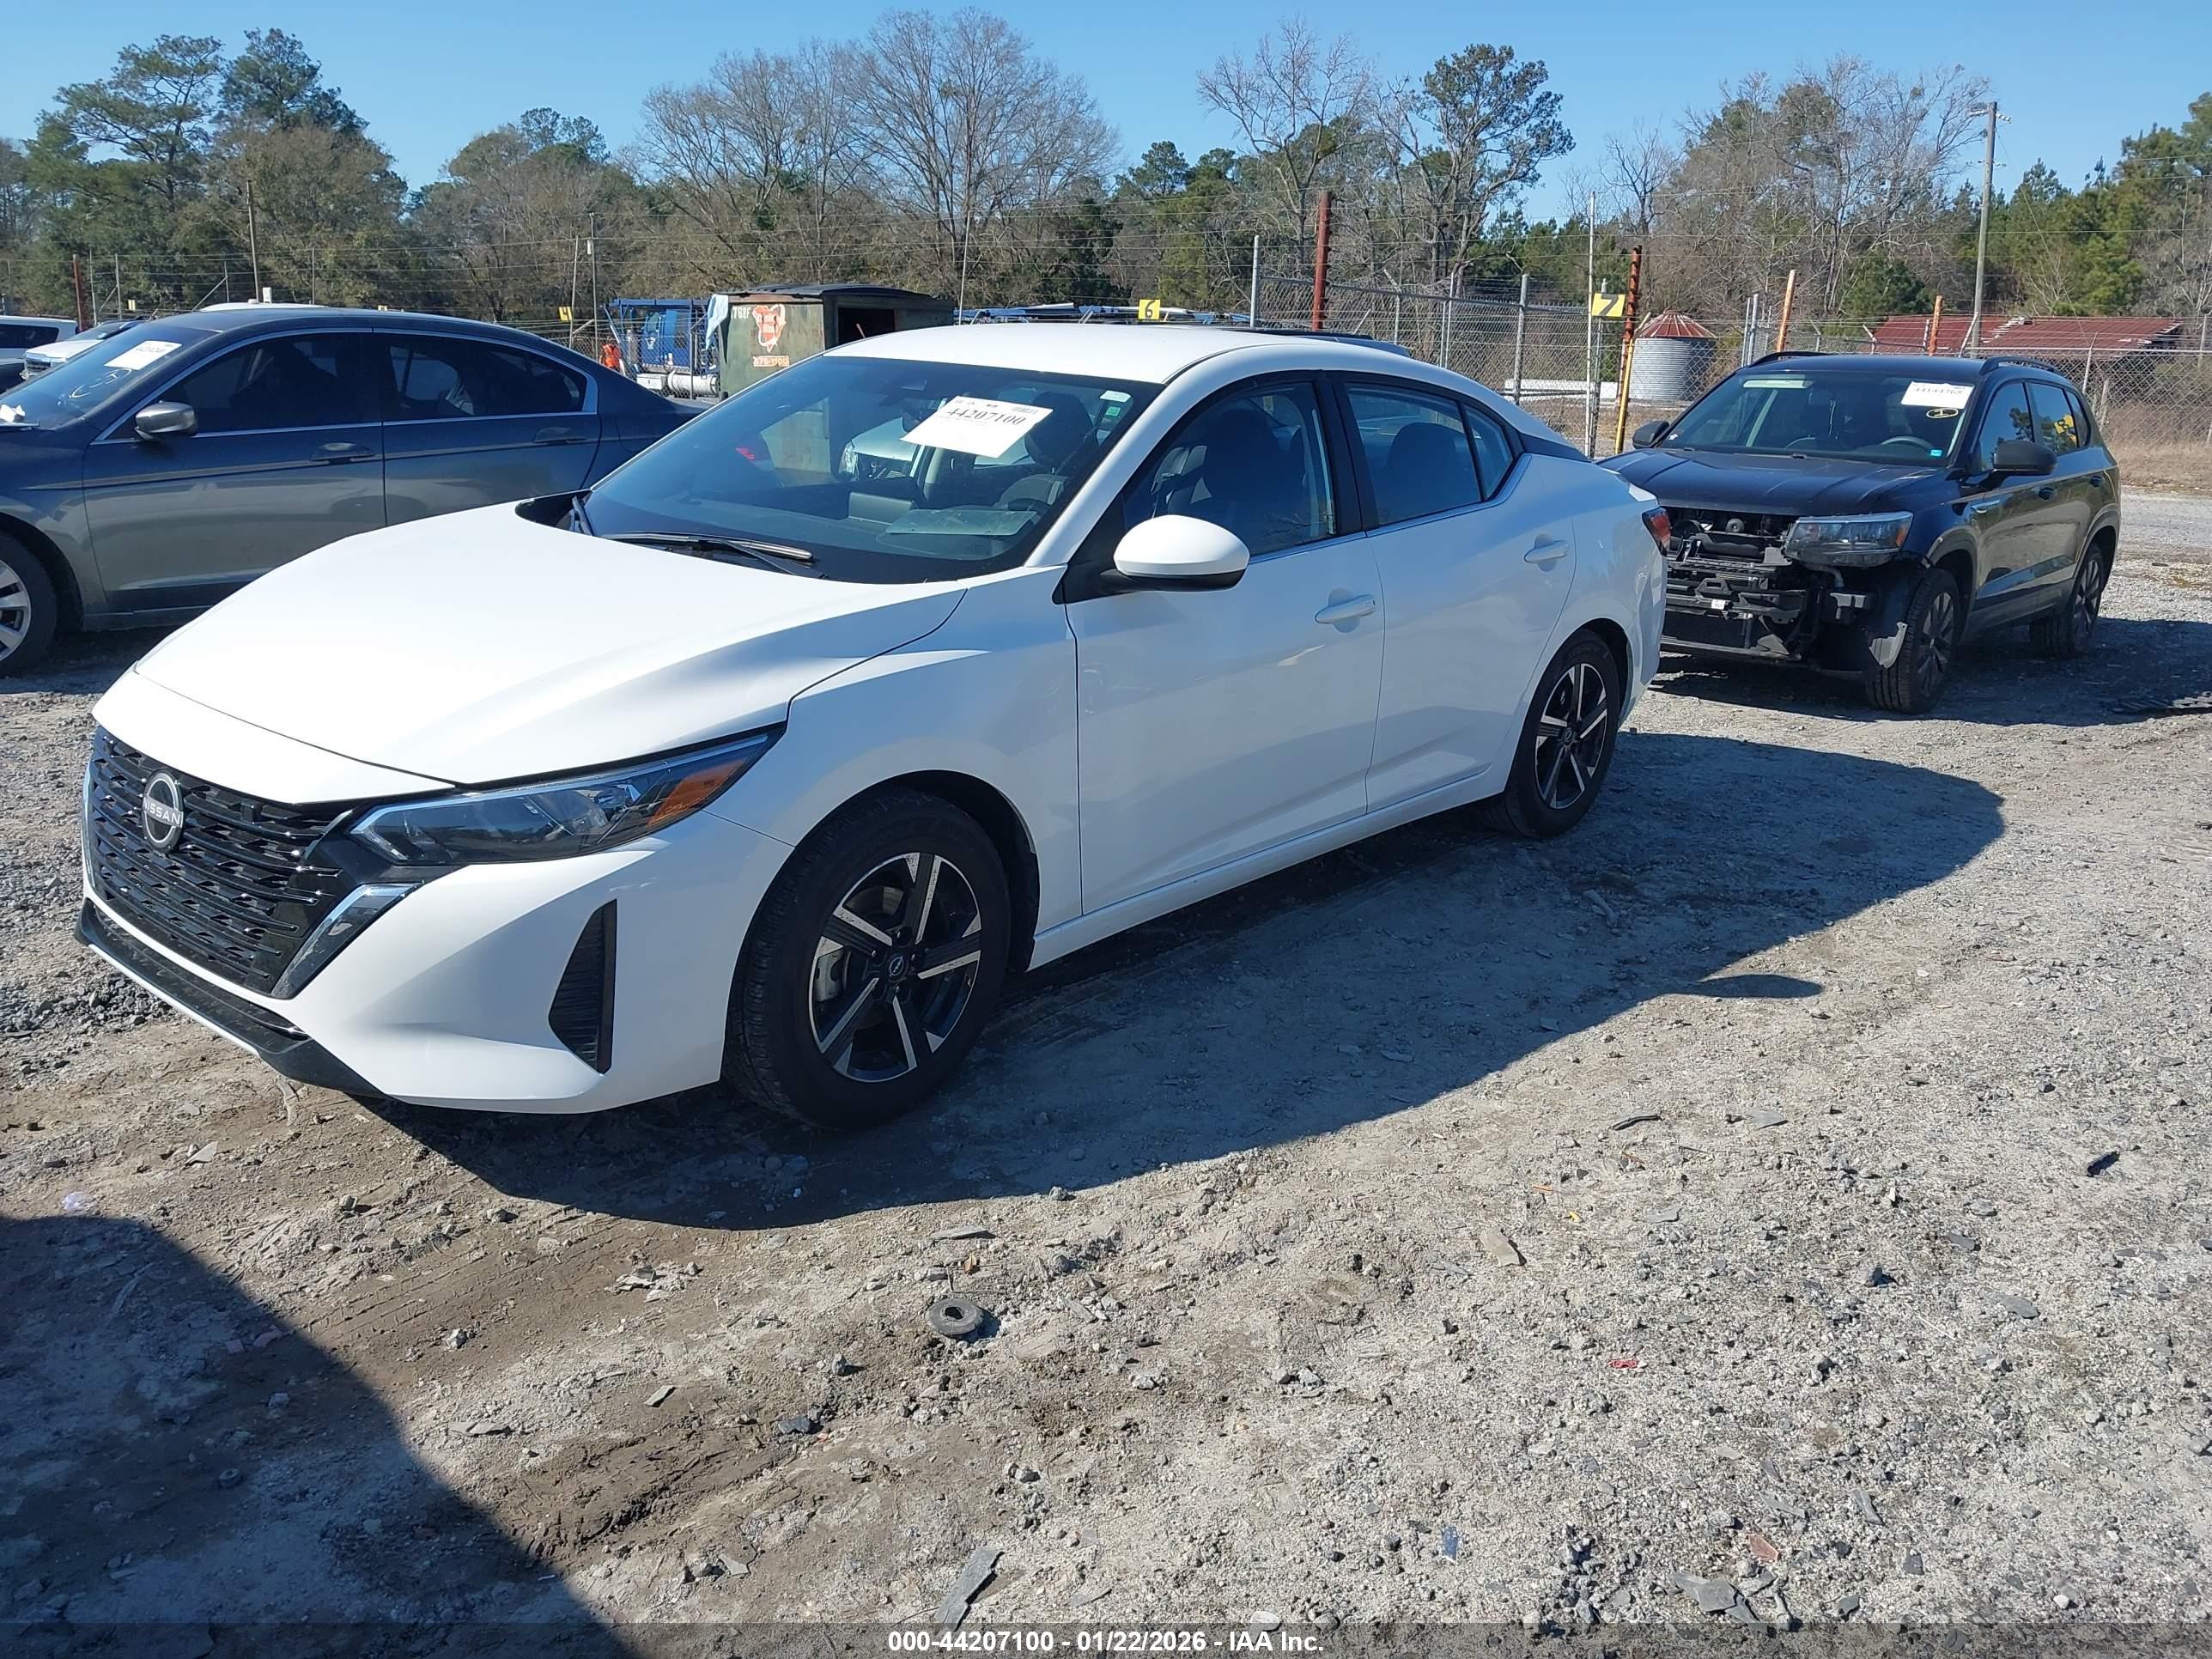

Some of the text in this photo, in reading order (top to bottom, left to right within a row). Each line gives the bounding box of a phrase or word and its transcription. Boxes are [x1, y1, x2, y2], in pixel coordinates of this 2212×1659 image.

[1145, 300, 1156, 319] 6
[1599, 294, 1619, 317] 7
[947, 408, 1026, 425] 44207100
[143, 797, 181, 825] NISSAN
